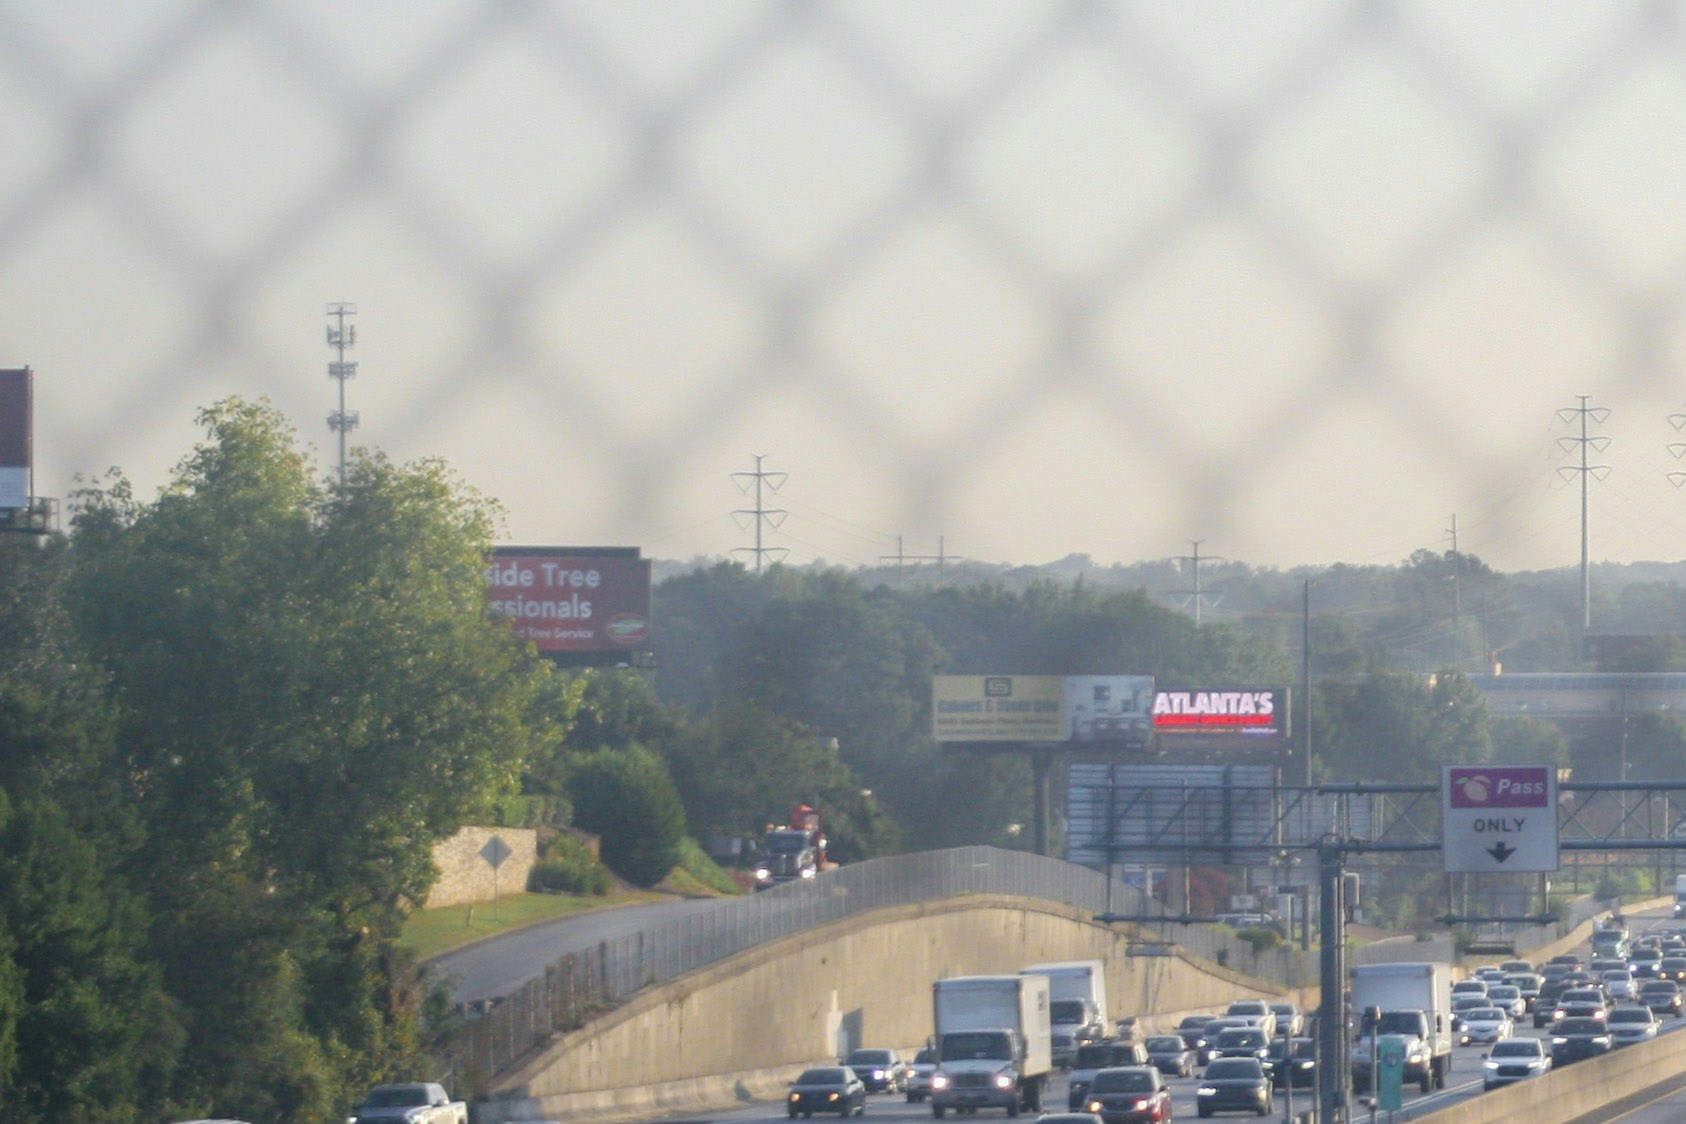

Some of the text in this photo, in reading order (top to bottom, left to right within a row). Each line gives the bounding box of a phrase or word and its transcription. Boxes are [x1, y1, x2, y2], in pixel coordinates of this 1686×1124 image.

[540, 562, 602, 588] Tree
[554, 627, 594, 639] Service
[1153, 692, 1274, 714] ATLANTA'S
[1497, 778, 1544, 795] Pass
[1473, 817, 1526, 833] ONLY
